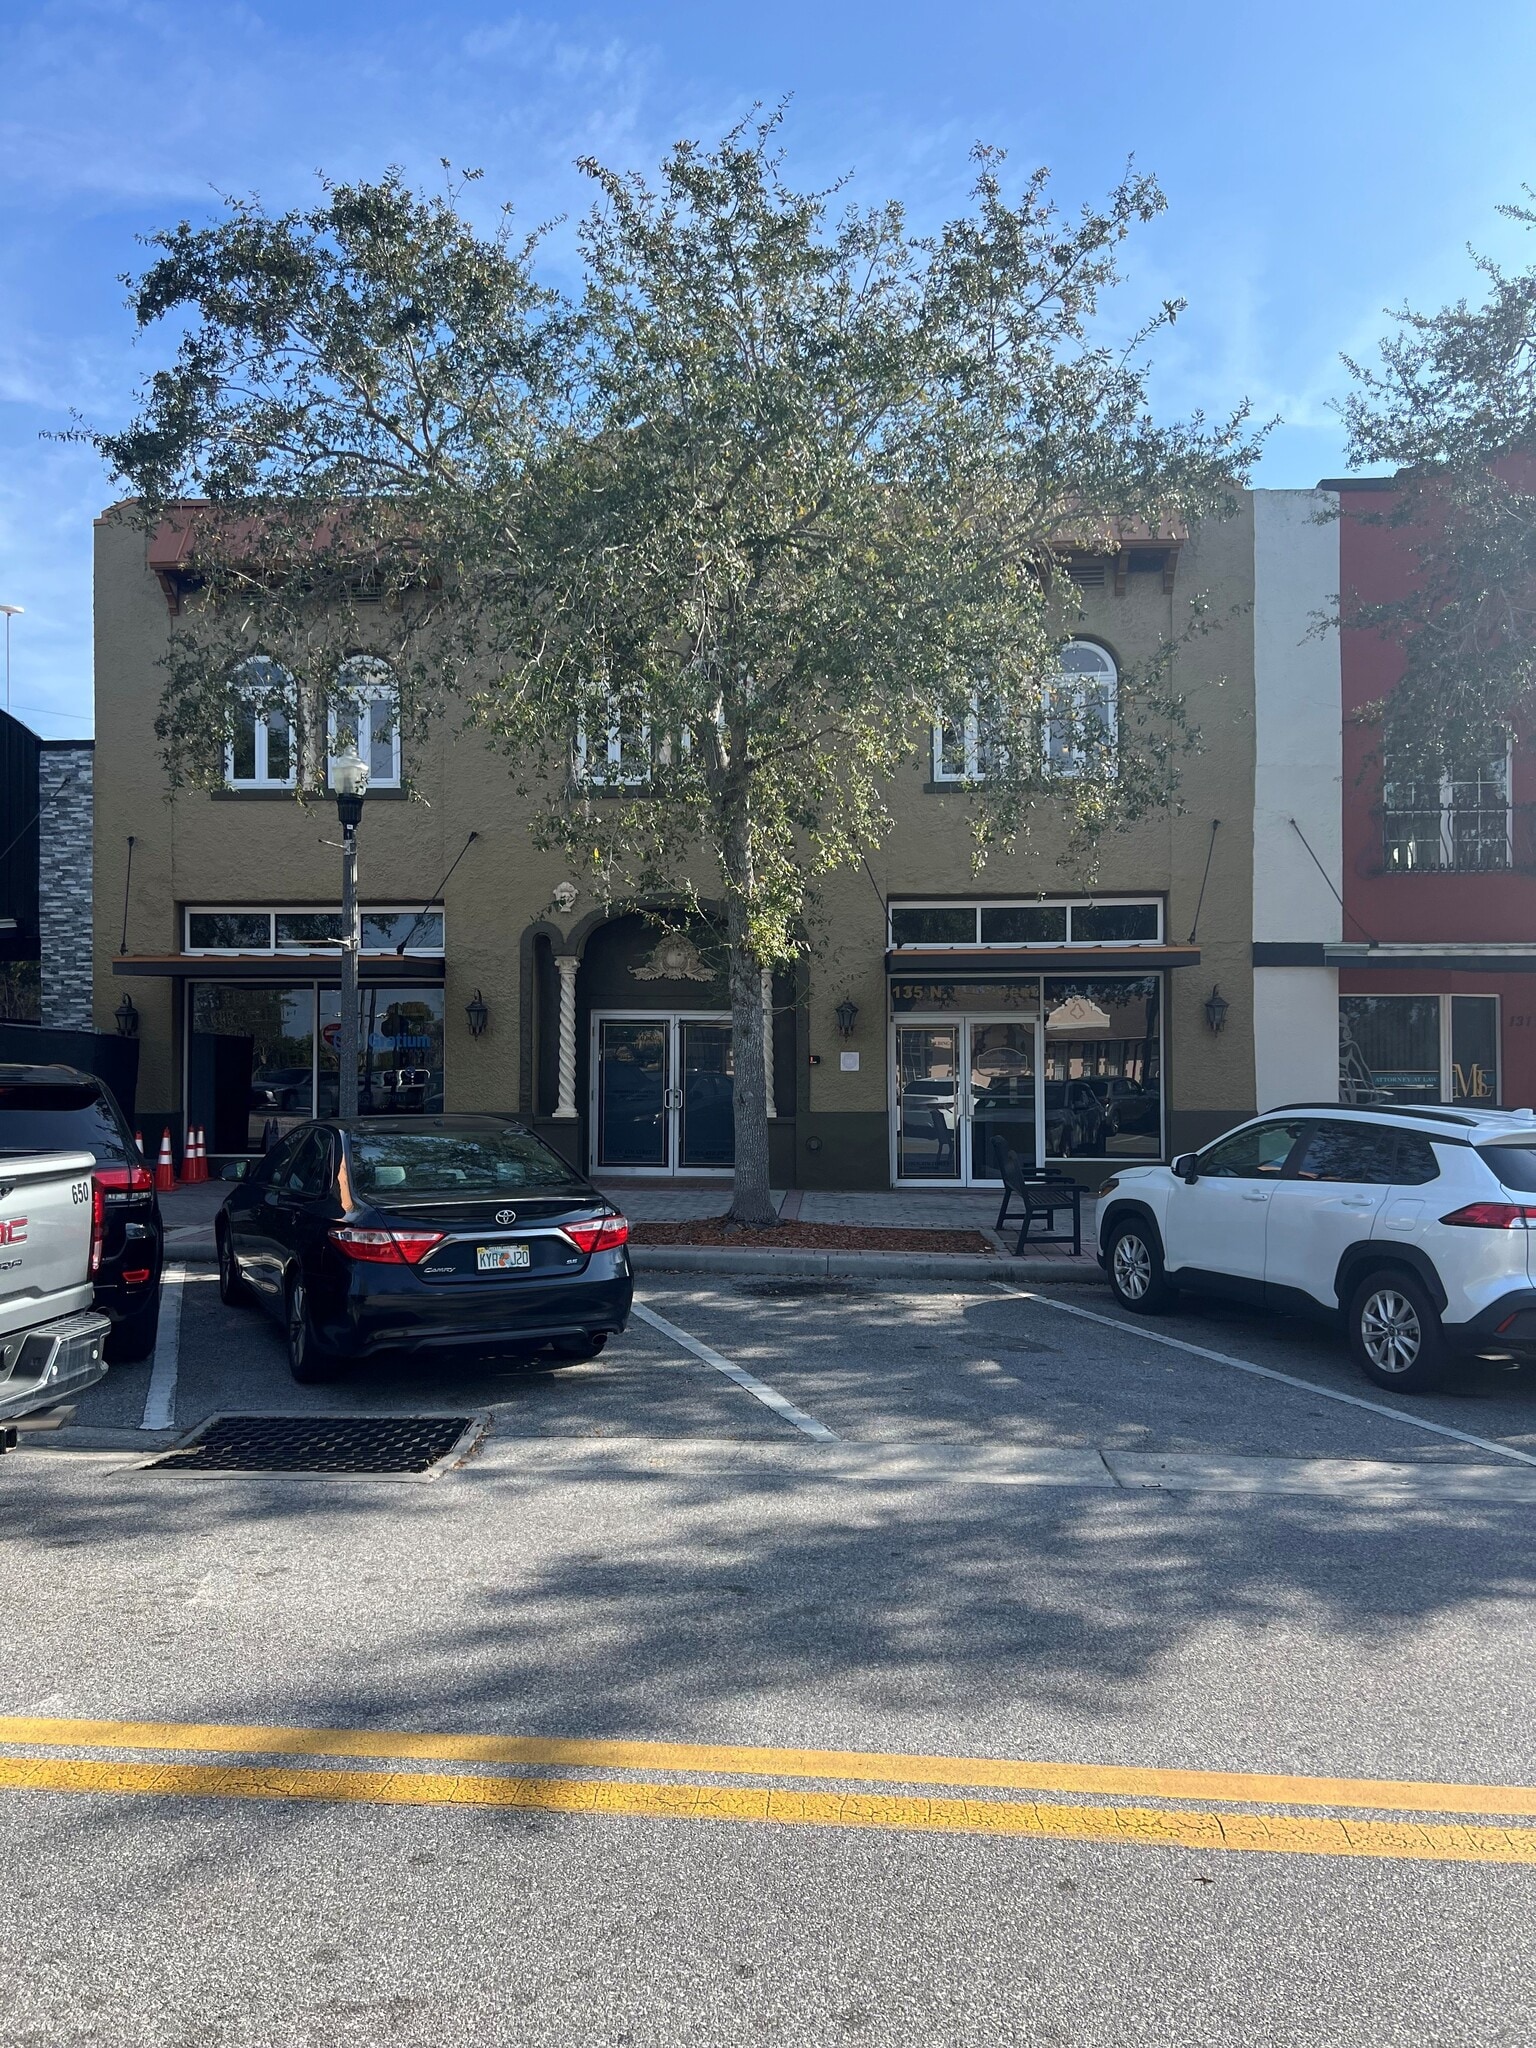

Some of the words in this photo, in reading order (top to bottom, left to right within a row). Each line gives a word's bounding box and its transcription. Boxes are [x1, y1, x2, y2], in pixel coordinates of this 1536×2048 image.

[892, 985, 923, 999] 135
[1509, 1015, 1532, 1027] 131
[71, 1181, 89, 1205] 650
[511, 1251, 529, 1265] J20
